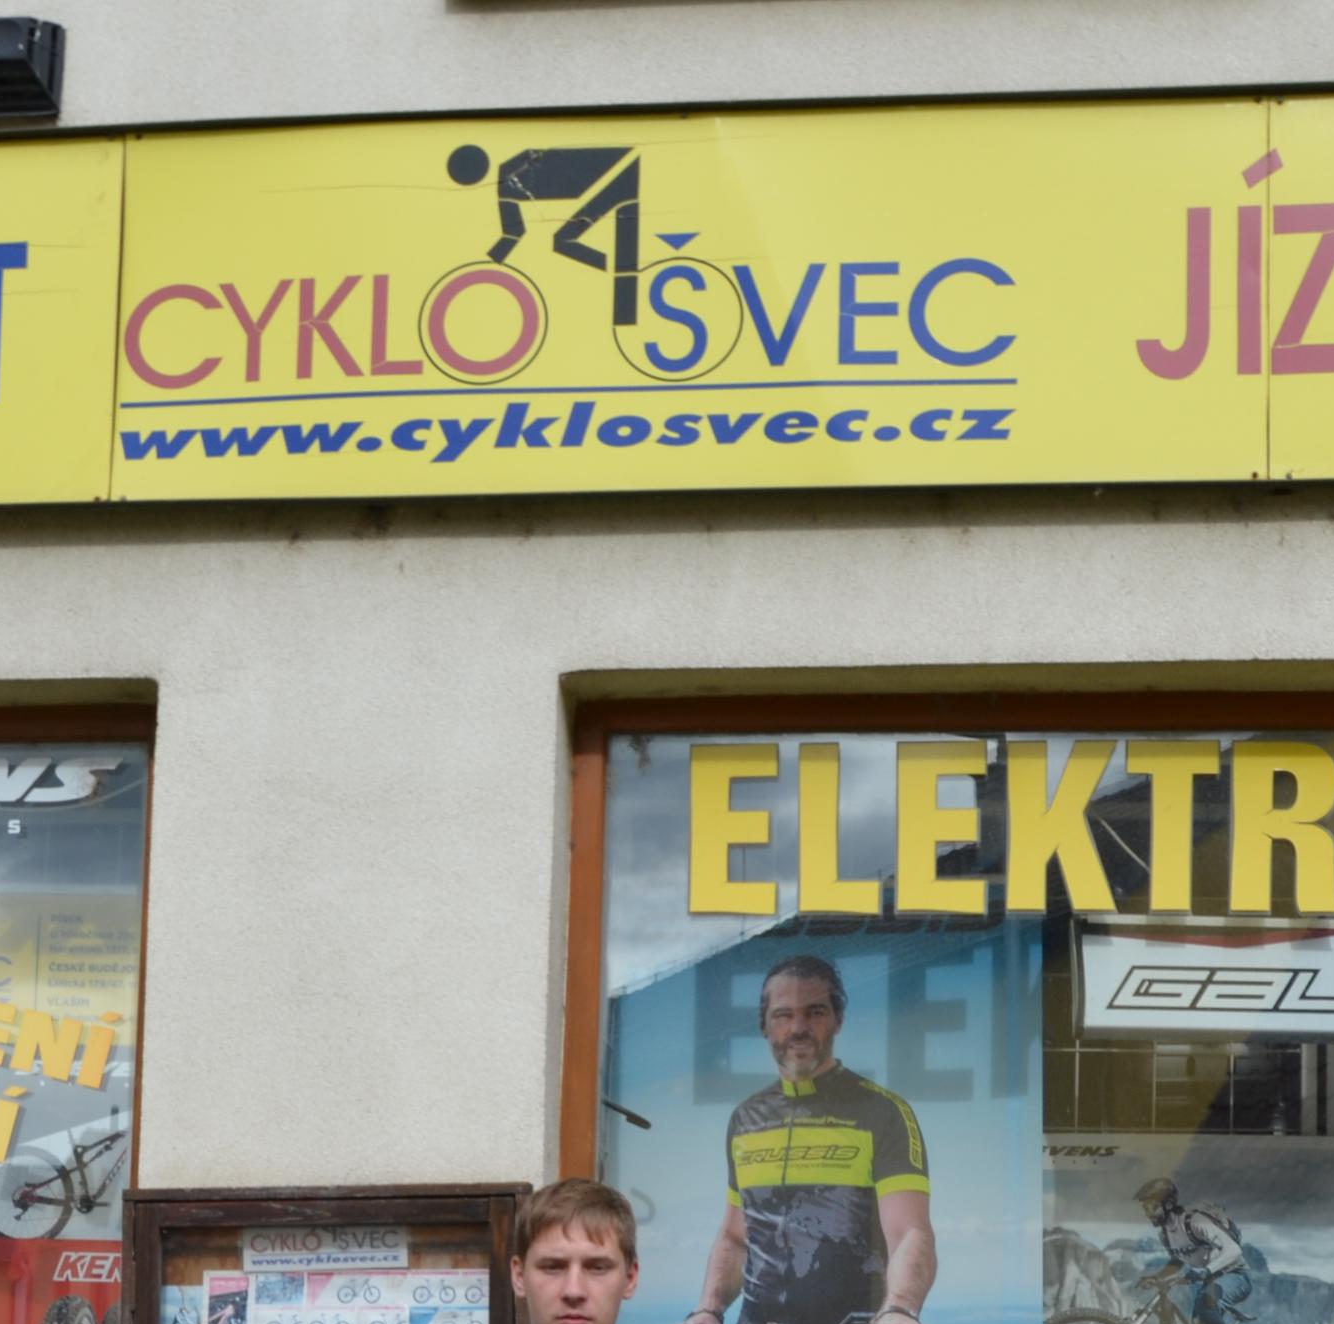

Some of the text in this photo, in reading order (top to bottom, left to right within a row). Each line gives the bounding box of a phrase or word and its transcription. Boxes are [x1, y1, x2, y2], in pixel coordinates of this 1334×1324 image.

[123, 230, 1019, 392] CYKLO ŠVEC
[118, 401, 1017, 464] www.cyklosvec.cz
